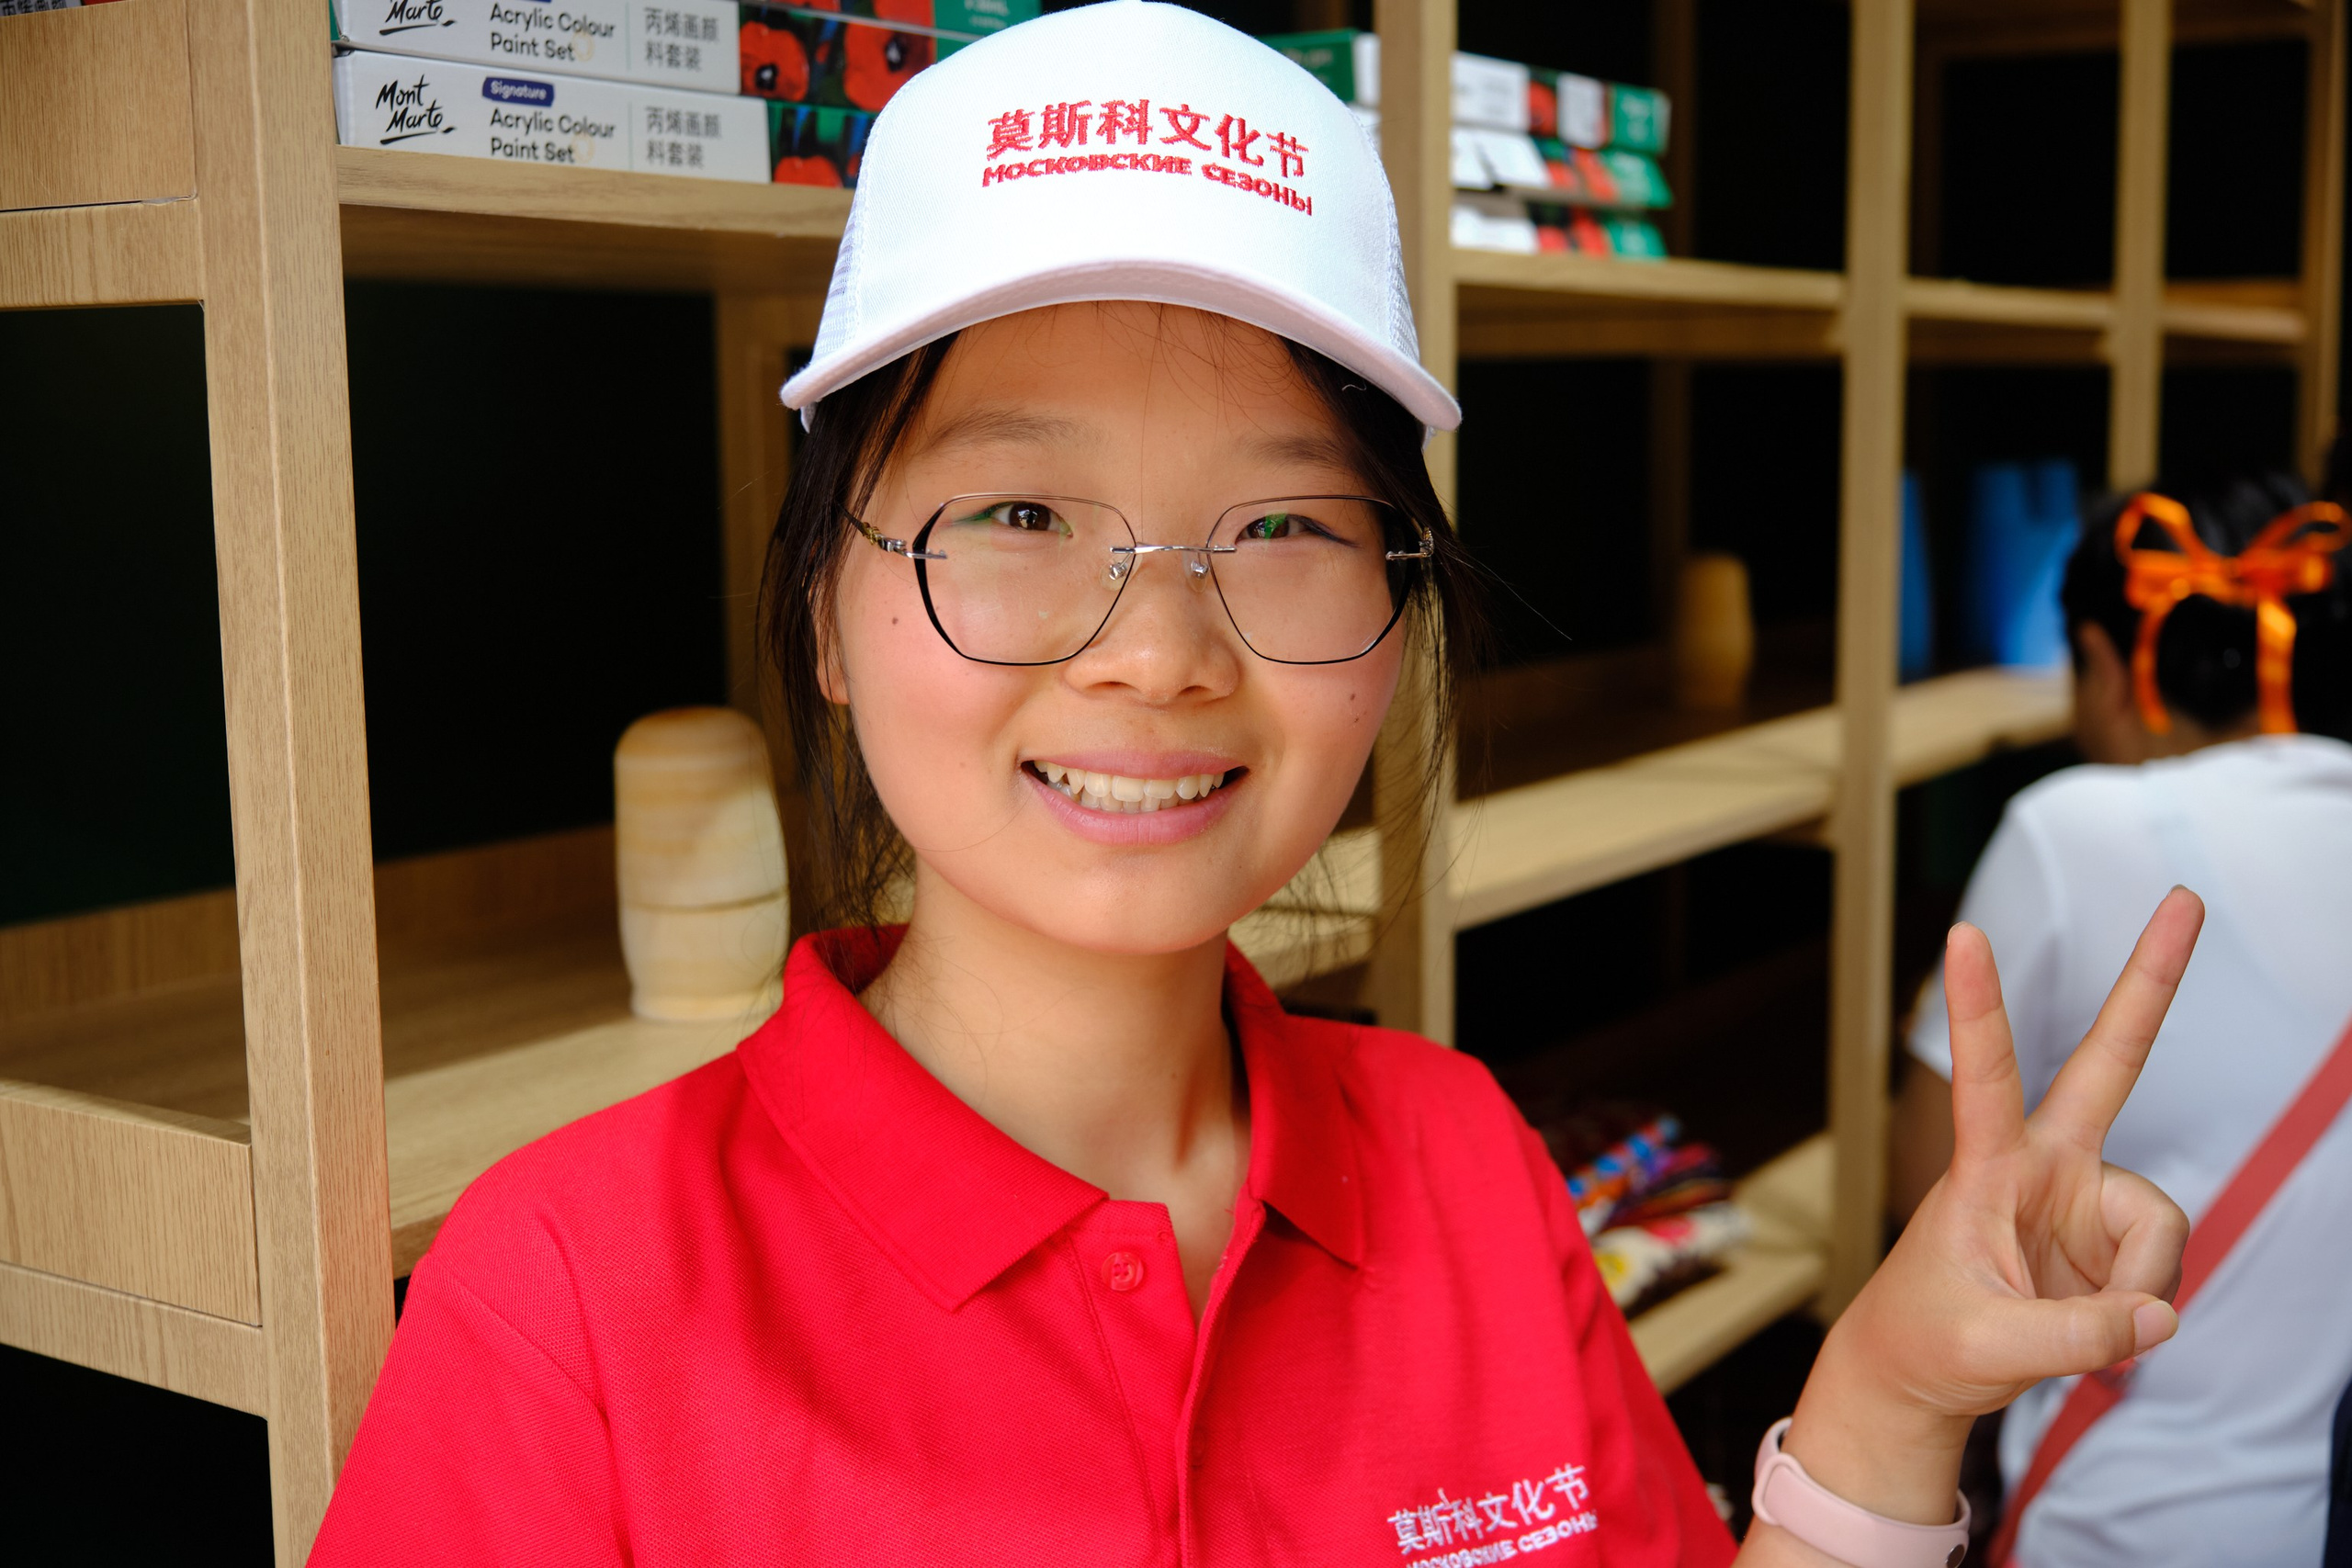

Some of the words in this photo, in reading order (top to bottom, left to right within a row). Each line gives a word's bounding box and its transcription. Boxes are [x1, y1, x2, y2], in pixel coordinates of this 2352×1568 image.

[490, 3, 553, 31] Acrylic
[558, 11, 616, 39] Colour
[491, 32, 540, 57] Paint
[544, 39, 576, 62] Set
[375, 73, 429, 112] Mont
[490, 80, 548, 100] Signature
[385, 99, 443, 132] Marte
[490, 107, 553, 135] Acrylic
[558, 114, 616, 139] Colour
[491, 137, 540, 160] Paint
[544, 141, 575, 164] Set
[987, 99, 1309, 177] 莫斯科文化节
[982, 153, 1193, 187] МОСКОВСКИЕ
[1202, 163, 1312, 216] СЕЗОНЫ
[1386, 1462, 1589, 1555] 莫斯科文化节
